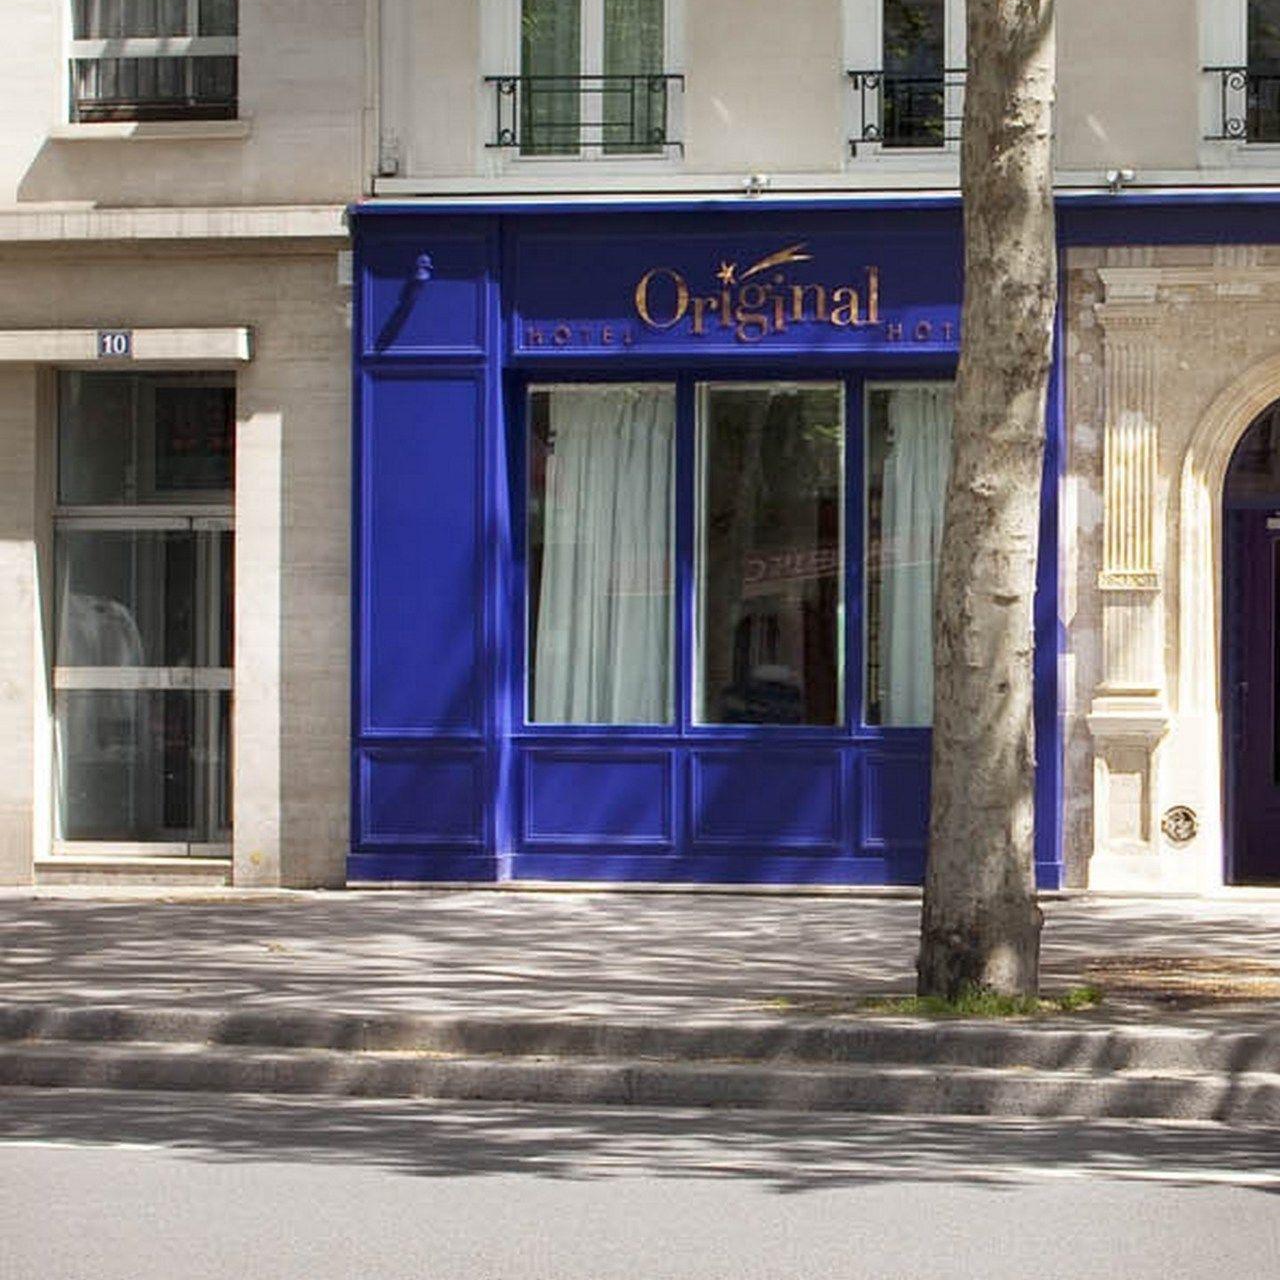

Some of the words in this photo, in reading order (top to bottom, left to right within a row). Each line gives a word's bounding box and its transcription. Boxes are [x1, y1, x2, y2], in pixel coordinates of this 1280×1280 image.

[634, 262, 883, 342] Original
[887, 321, 954, 342] HOT
[103, 335, 126, 354] 10
